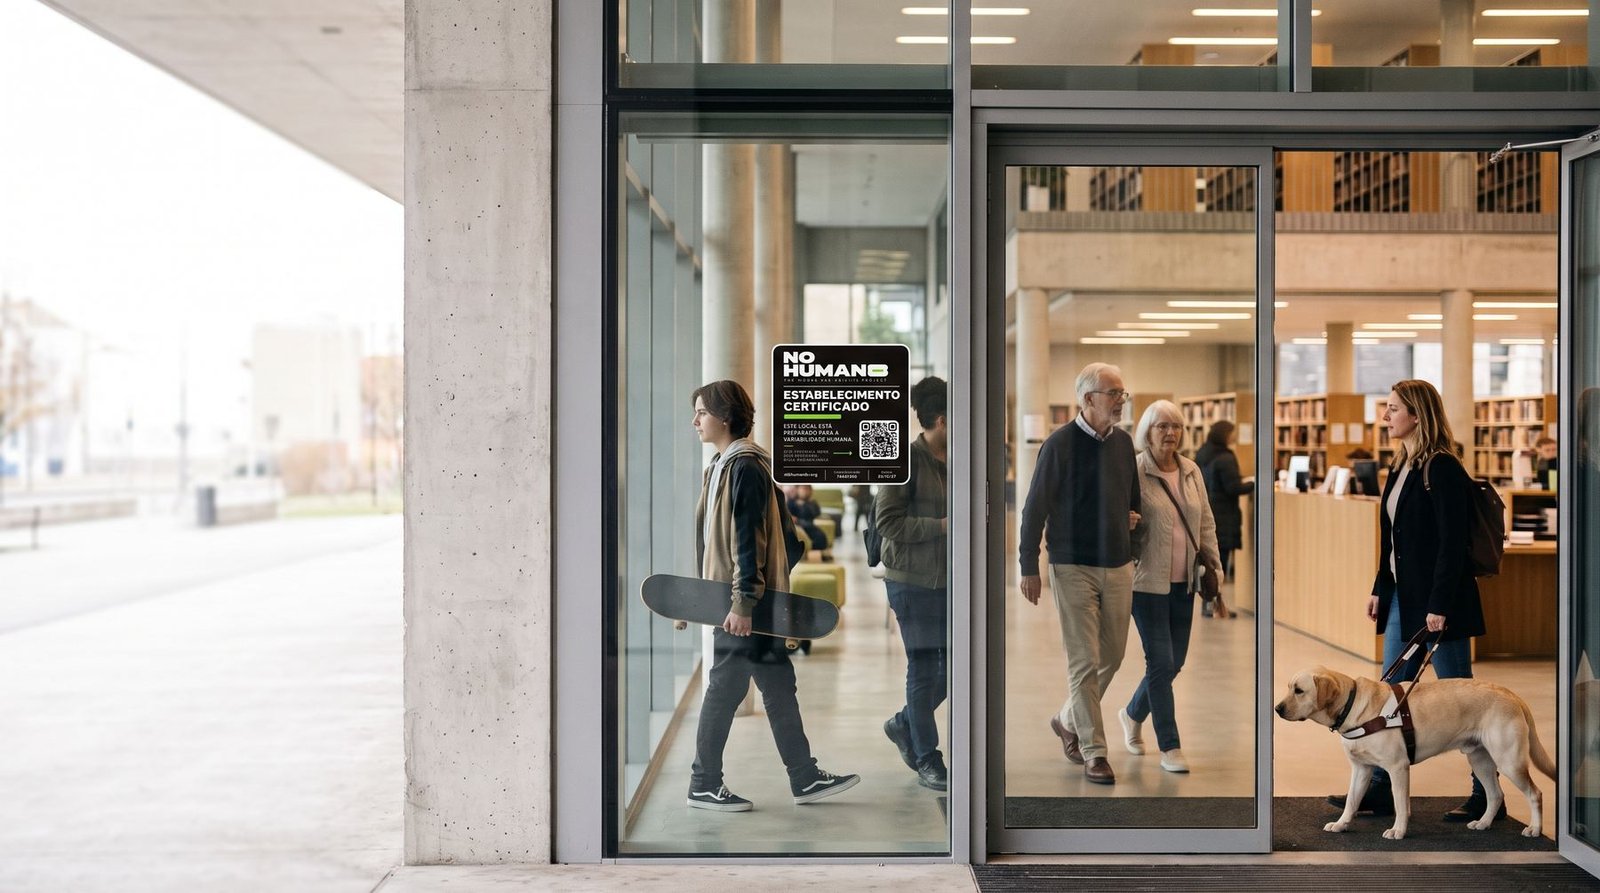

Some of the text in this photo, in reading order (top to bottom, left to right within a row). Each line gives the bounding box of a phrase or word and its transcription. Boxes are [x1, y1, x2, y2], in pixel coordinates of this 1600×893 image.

[783, 351, 815, 364] NO
[783, 390, 900, 400] ESTABELECIMENTO
[783, 401, 870, 412] CERTIFICADO
